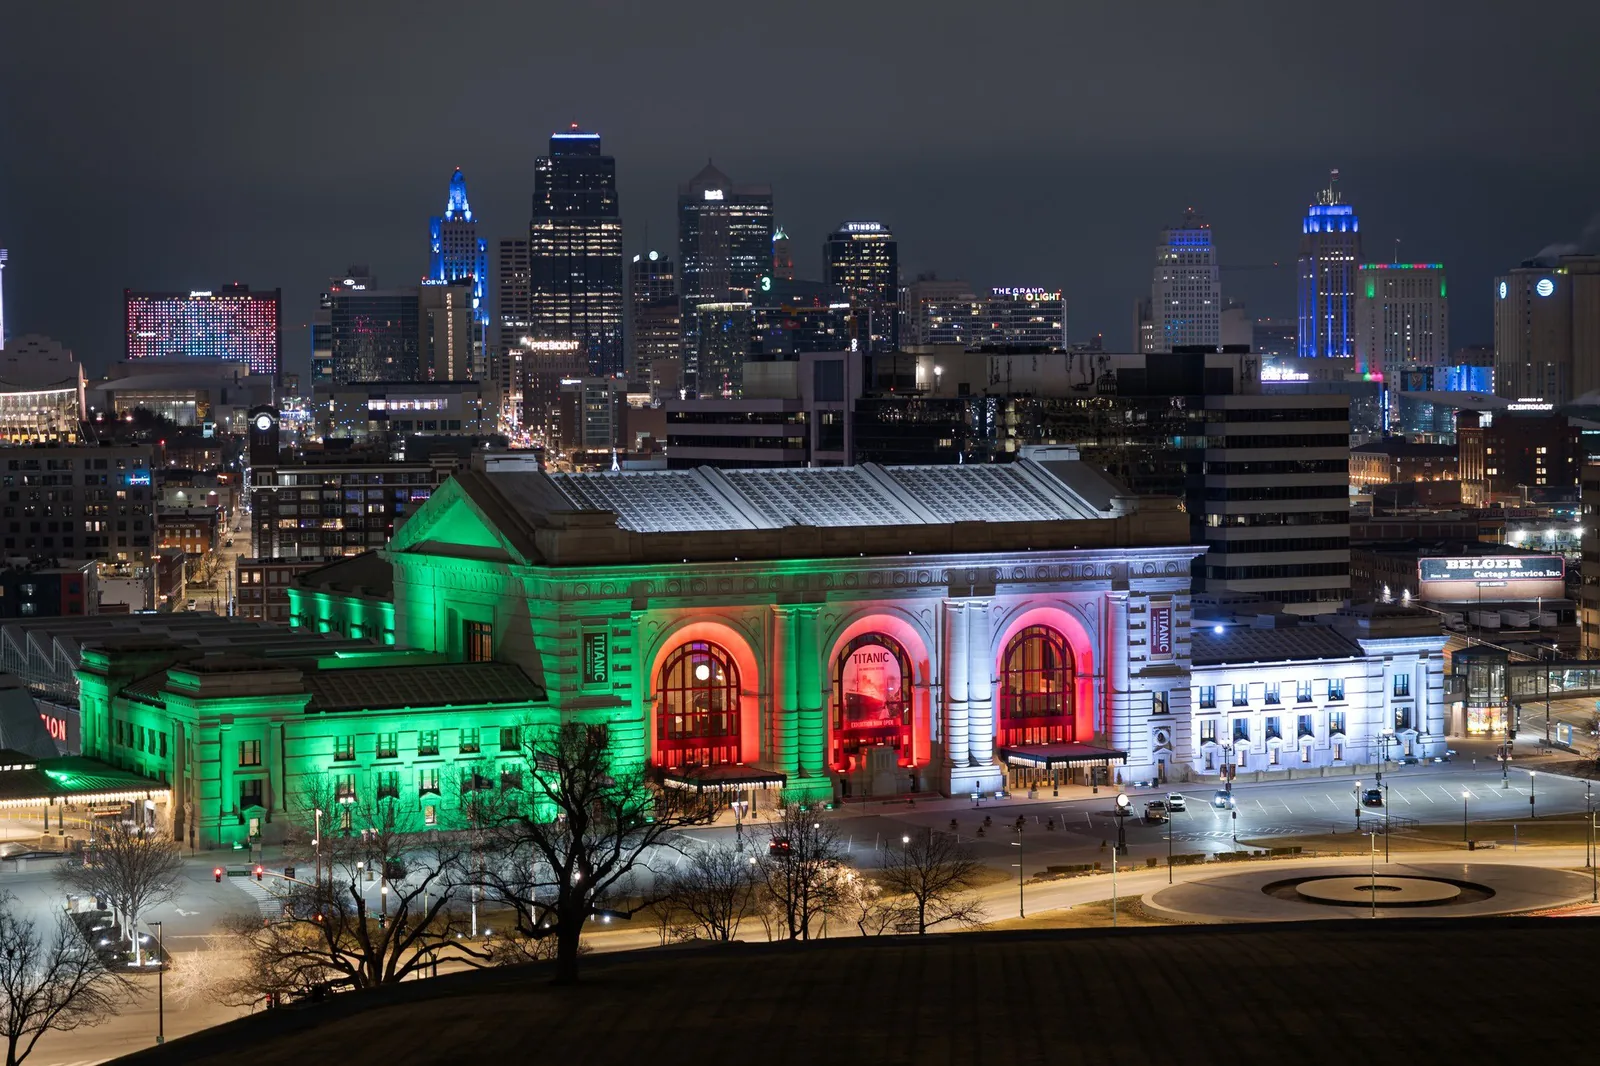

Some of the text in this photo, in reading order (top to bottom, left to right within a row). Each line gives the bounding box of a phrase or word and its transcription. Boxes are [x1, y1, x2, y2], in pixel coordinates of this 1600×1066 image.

[761, 276, 771, 291] 3
[1035, 293, 1061, 301] LIGHT
[531, 341, 579, 350] PRESIDENT
[1445, 559, 1523, 569] BELGER
[1474, 570, 1508, 579] Cartage
[1159, 609, 1169, 652] TITANIC
[594, 634, 605, 681] TITANIC
[853, 652, 889, 664] TITANIC
